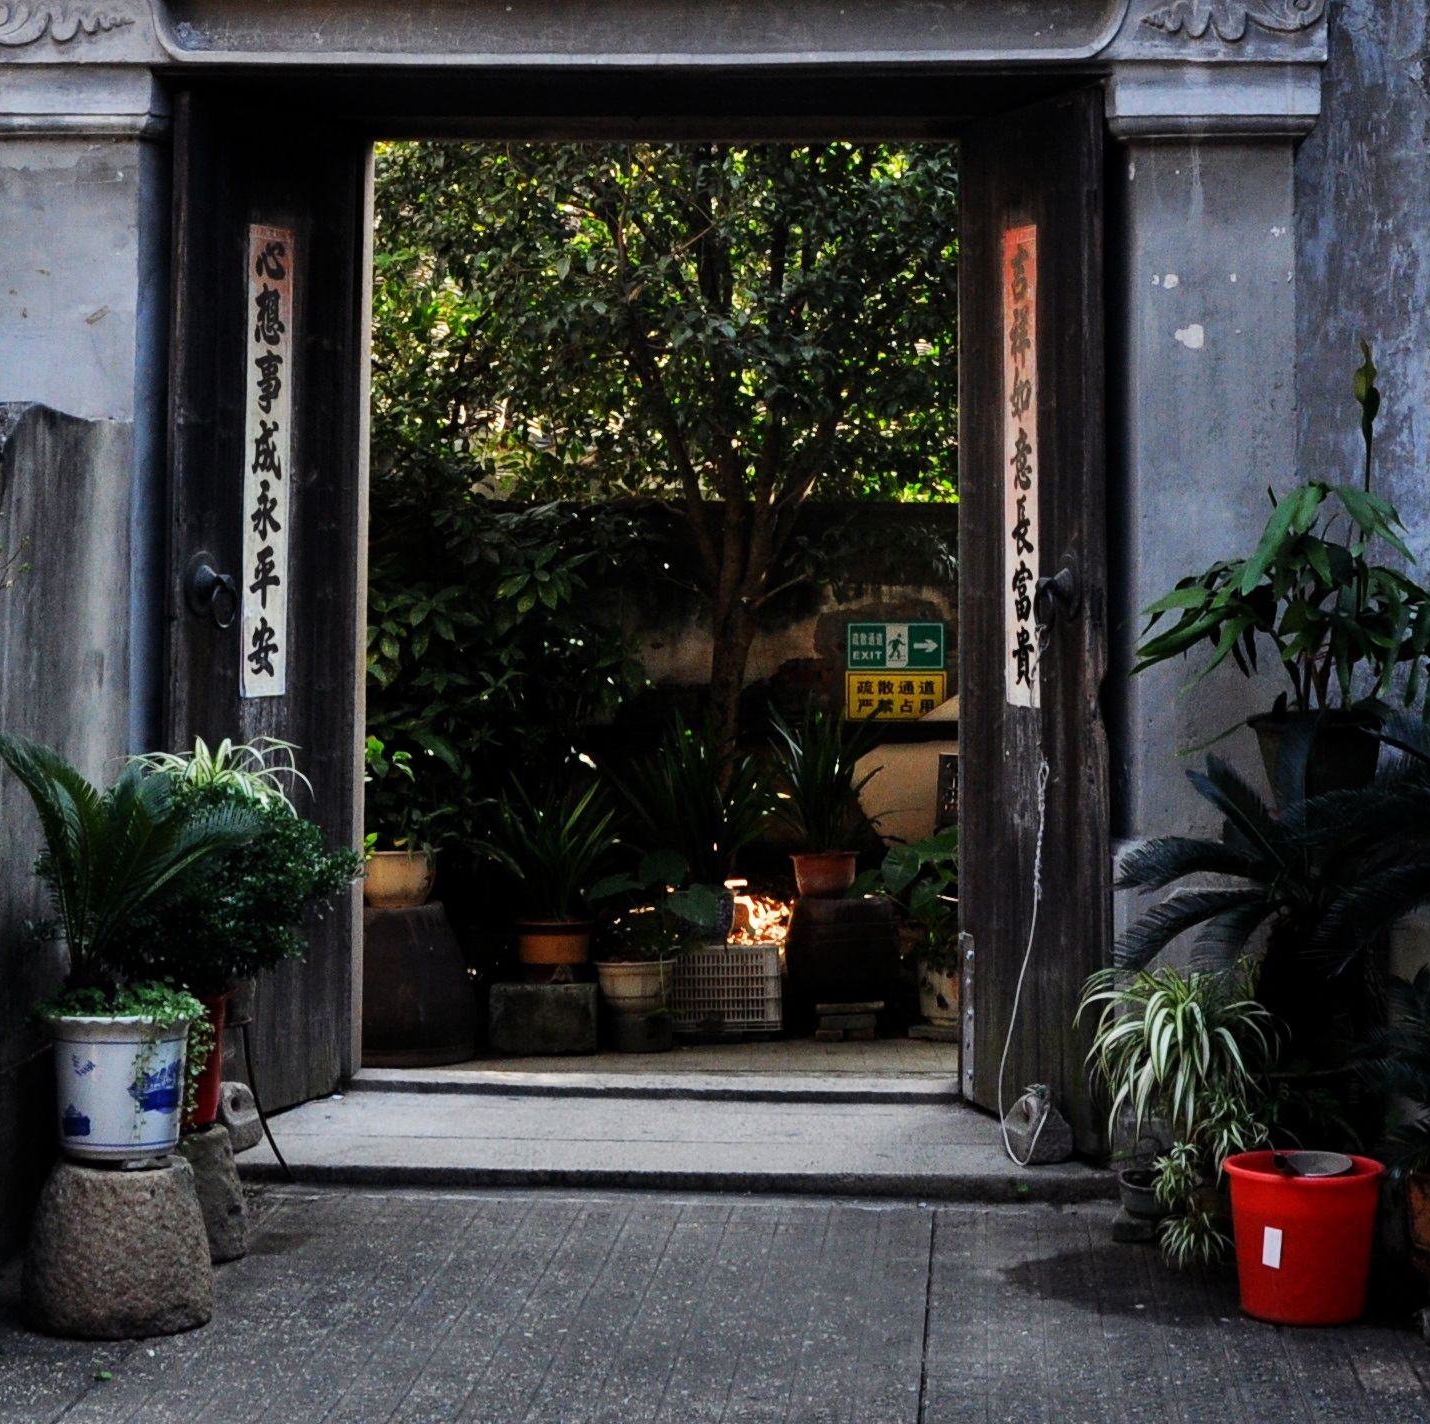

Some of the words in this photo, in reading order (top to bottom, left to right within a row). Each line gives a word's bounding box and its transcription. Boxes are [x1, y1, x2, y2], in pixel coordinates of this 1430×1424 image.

[247, 240, 286, 678] 心想事成永平安
[1009, 242, 1035, 686] 吉祥如意長富貴
[852, 650, 883, 661] EXIT
[856, 680, 935, 694] 疏散通道
